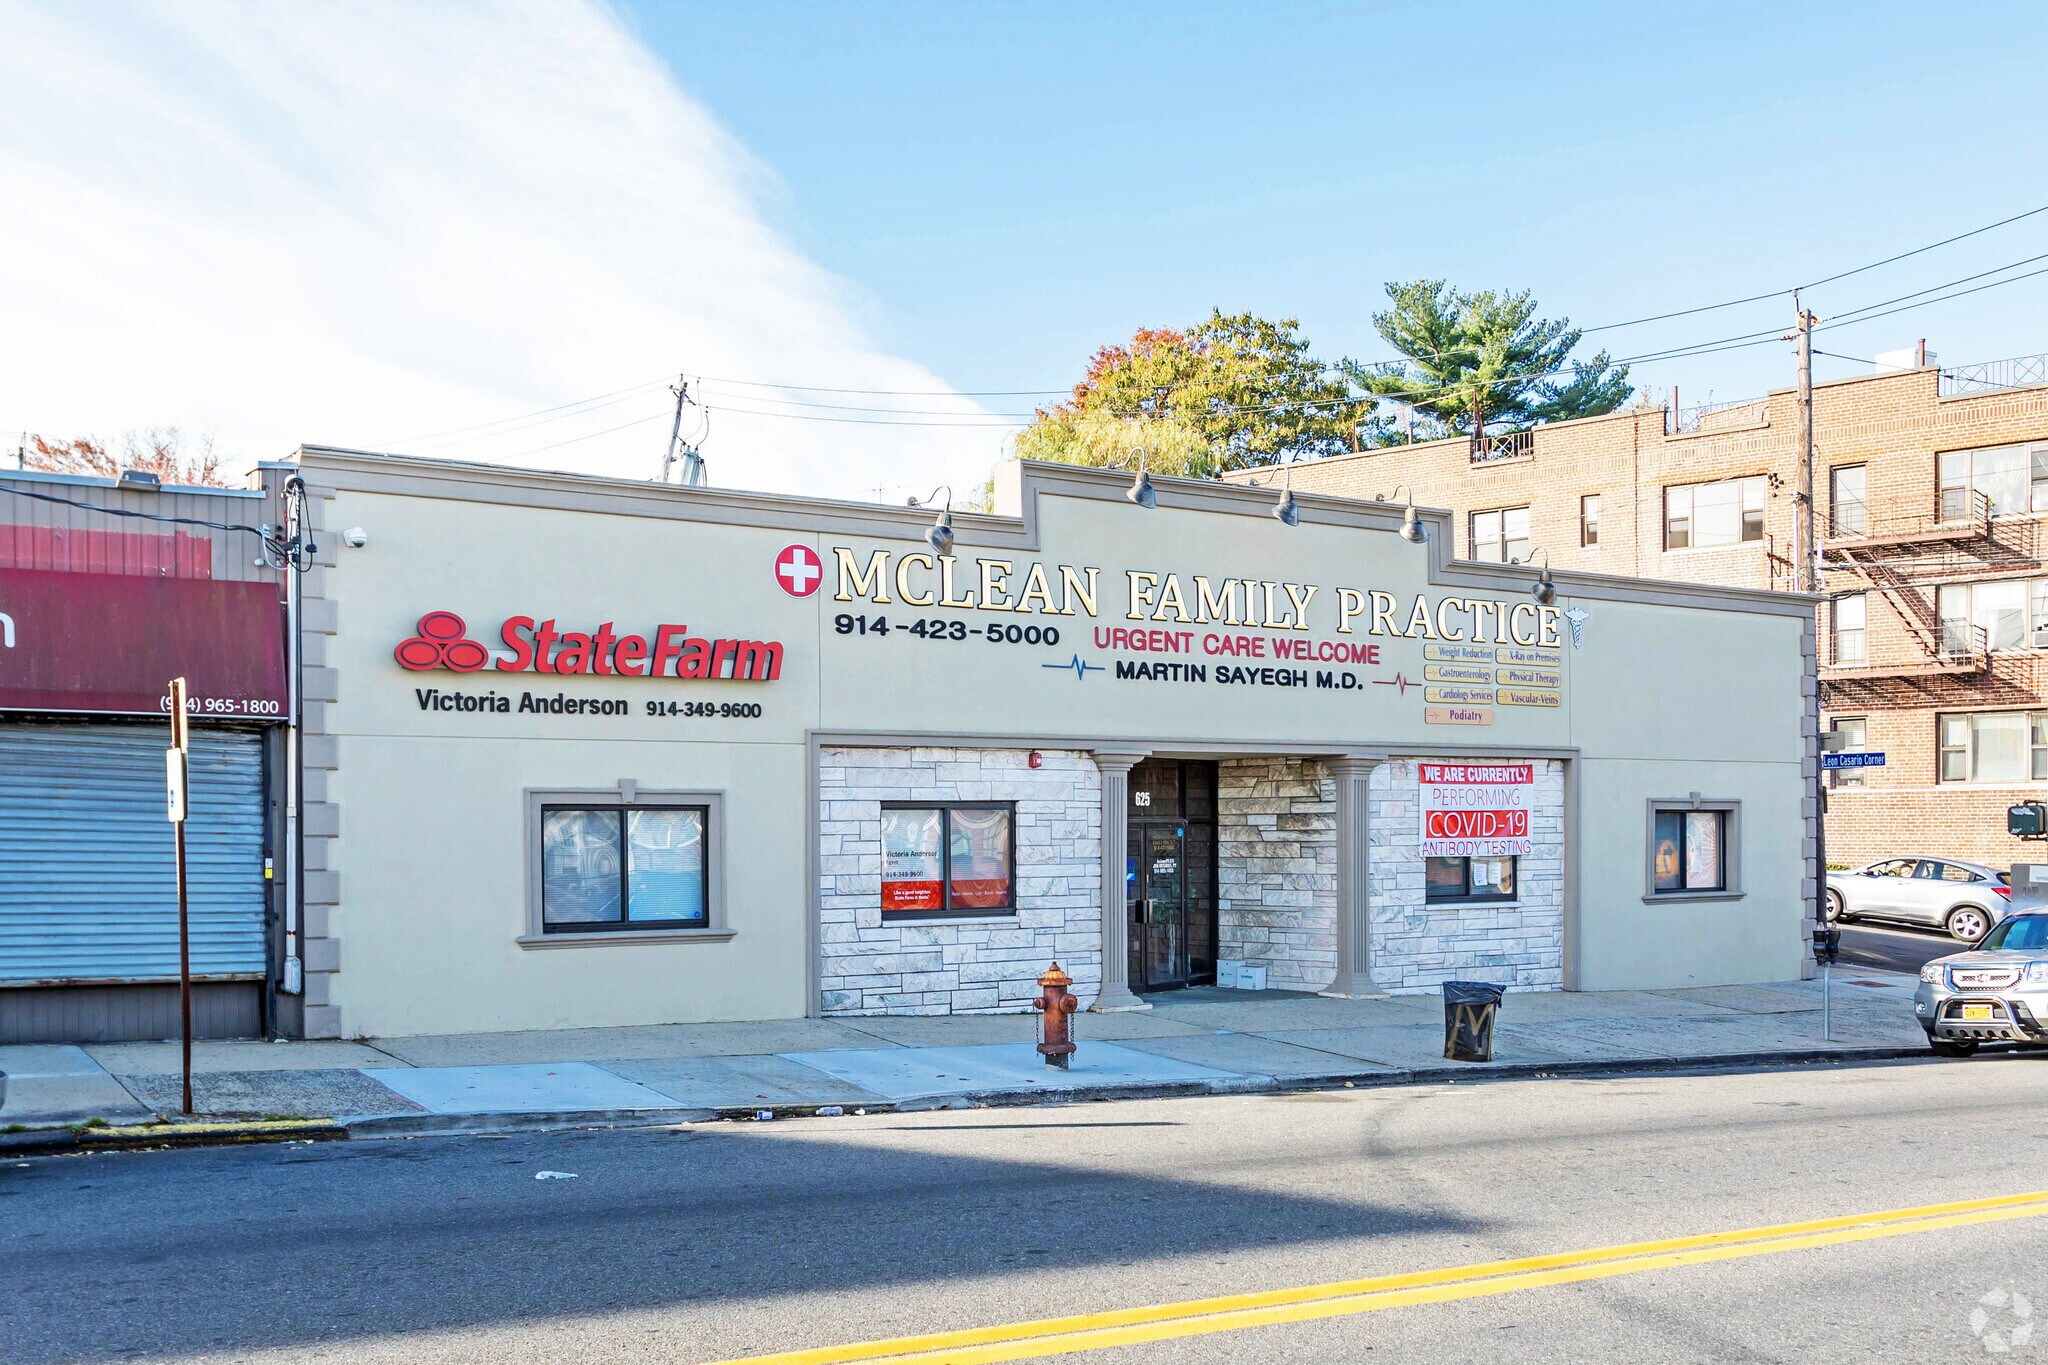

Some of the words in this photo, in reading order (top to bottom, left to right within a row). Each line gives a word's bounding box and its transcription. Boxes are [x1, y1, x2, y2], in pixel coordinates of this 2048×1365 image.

[833, 547, 1100, 617] MCLEAN
[1126, 569, 1318, 631] FAMILY
[1336, 587, 1561, 648] PRACTICE
[834, 613, 1060, 646] 914-423-5000
[1094, 626, 1194, 653] URGENT
[1203, 634, 1265, 658] CARE
[1271, 638, 1380, 665] WELCOME
[1438, 646, 1460, 660] Weight
[1462, 647, 1493, 659] Reduction
[1510, 650, 1525, 664] X-Ray
[1526, 654, 1534, 662] on
[1535, 652, 1560, 663] Premises
[1116, 660, 1206, 683] MARTIN
[1215, 665, 1307, 688] SAYEGH
[1316, 671, 1363, 690] M.D.
[1438, 667, 1491, 683] Gastroenterology
[1509, 671, 1533, 684] Physical
[1535, 672, 1559, 688] Therapy
[415, 688, 511, 714] Victoria
[518, 691, 628, 716] Anderson
[646, 700, 763, 719] 914-349-9600
[1438, 688, 1468, 703] Cardiology
[1470, 689, 1493, 701] Services
[1510, 692, 1559, 705] Vascular-Veins
[160, 695, 201, 713] (94)
[205, 697, 279, 715] 965-1800
[1449, 709, 1483, 724] Podiatry
[1823, 756, 1838, 766] Leon
[1840, 755, 1863, 766] Casario
[1864, 754, 1884, 765] Corner
[1424, 766, 1442, 782] WE
[1444, 767, 1465, 782] ARE
[1467, 766, 1528, 783] CURRENTLY
[1135, 792, 1150, 807] 625
[1432, 788, 1520, 807] PERFORMING
[1428, 811, 1526, 838] COVID-19
[1422, 841, 1482, 856] ANTIBODY
[1485, 839, 1532, 855] TESTING
